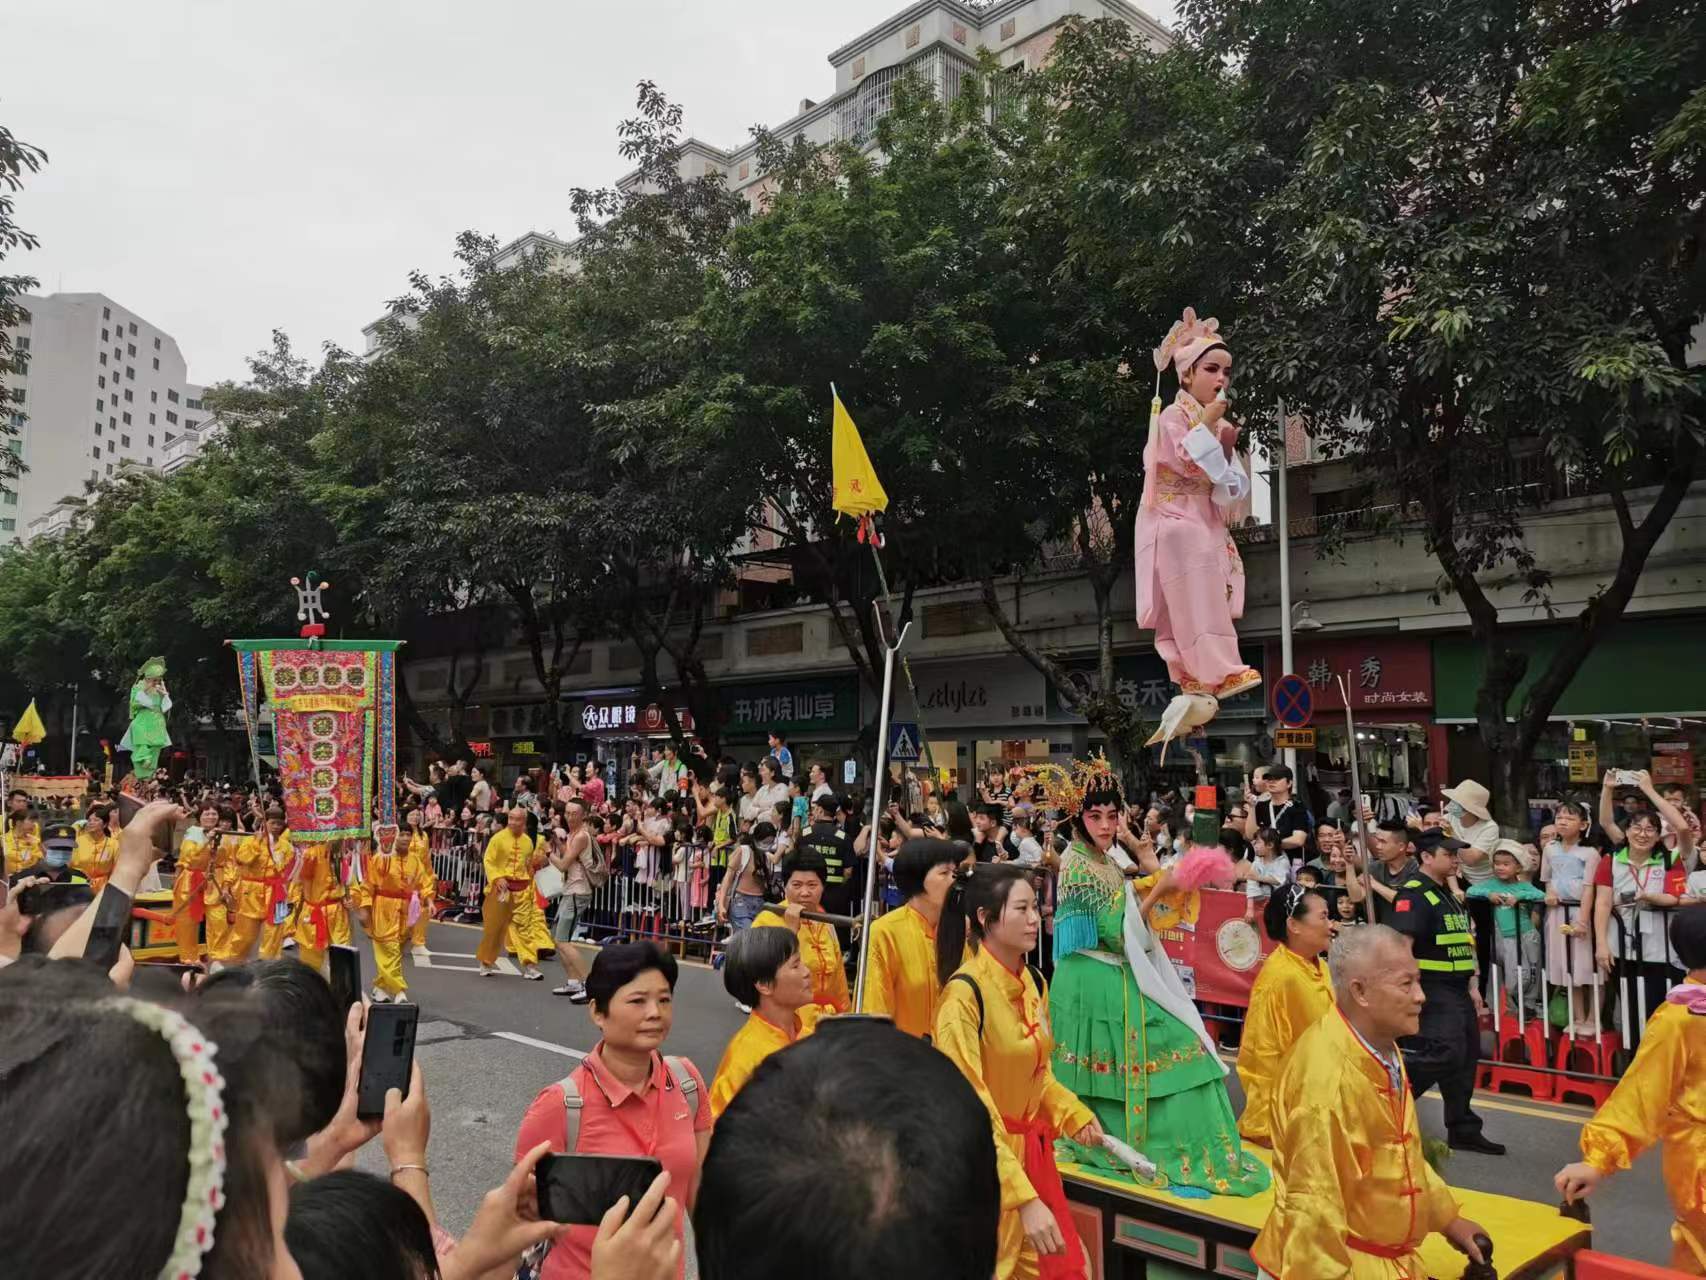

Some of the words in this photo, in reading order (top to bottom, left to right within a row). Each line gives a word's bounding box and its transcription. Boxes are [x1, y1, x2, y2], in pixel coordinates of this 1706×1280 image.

[1308, 656, 1382, 690] 韩秀
[736, 693, 835, 722] 书亦烧仙草
[1365, 690, 1428, 704] 时尚女装
[583, 705, 636, 728] 大众眼镜
